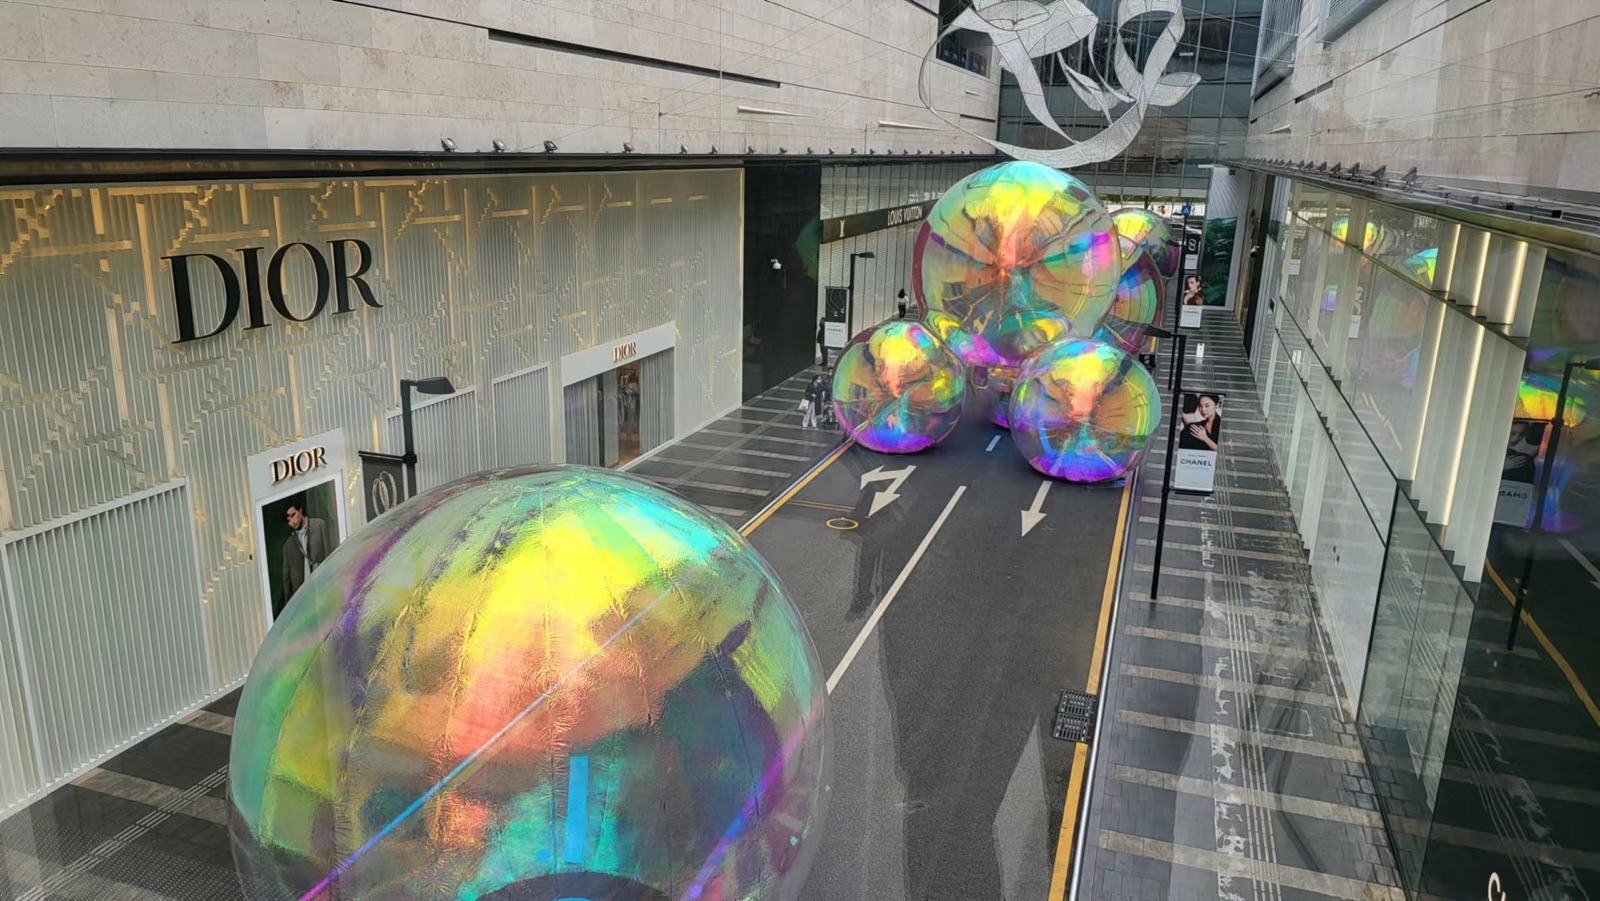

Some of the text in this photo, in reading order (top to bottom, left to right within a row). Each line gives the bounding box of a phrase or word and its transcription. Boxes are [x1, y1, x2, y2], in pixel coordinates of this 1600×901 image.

[887, 204, 923, 226] LOUIS VUITTON
[160, 239, 384, 344] DIOR
[612, 341, 637, 362] DIOR
[270, 446, 328, 485] DIOR
[1180, 458, 1213, 467] CHANEL
